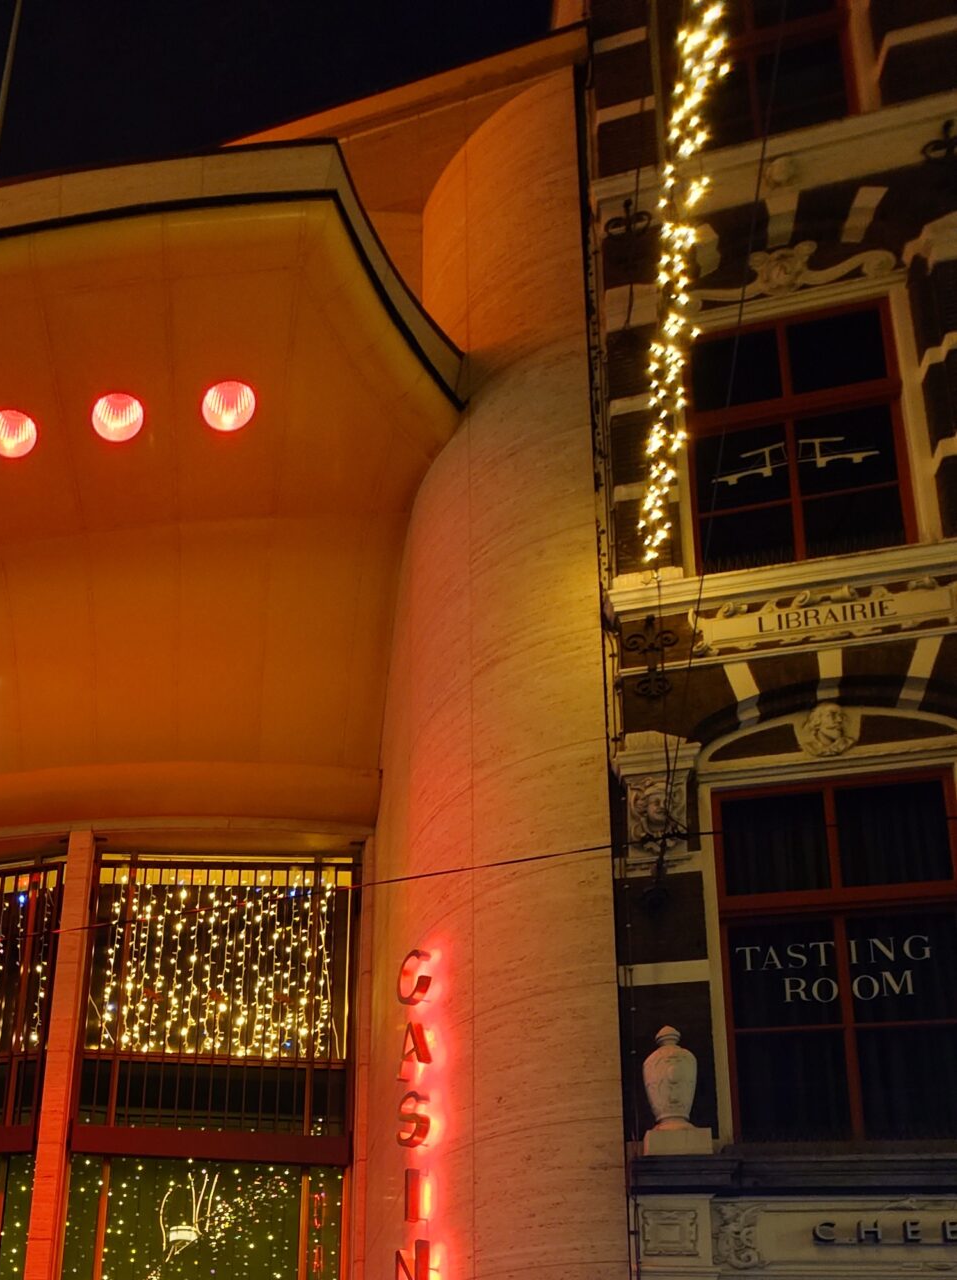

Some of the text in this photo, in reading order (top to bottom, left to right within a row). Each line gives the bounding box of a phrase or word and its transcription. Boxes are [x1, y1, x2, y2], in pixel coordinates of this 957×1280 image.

[757, 599, 898, 634] LIBRAIRIE
[735, 934, 932, 972] TASTING
[783, 969, 915, 1003] ROOM
